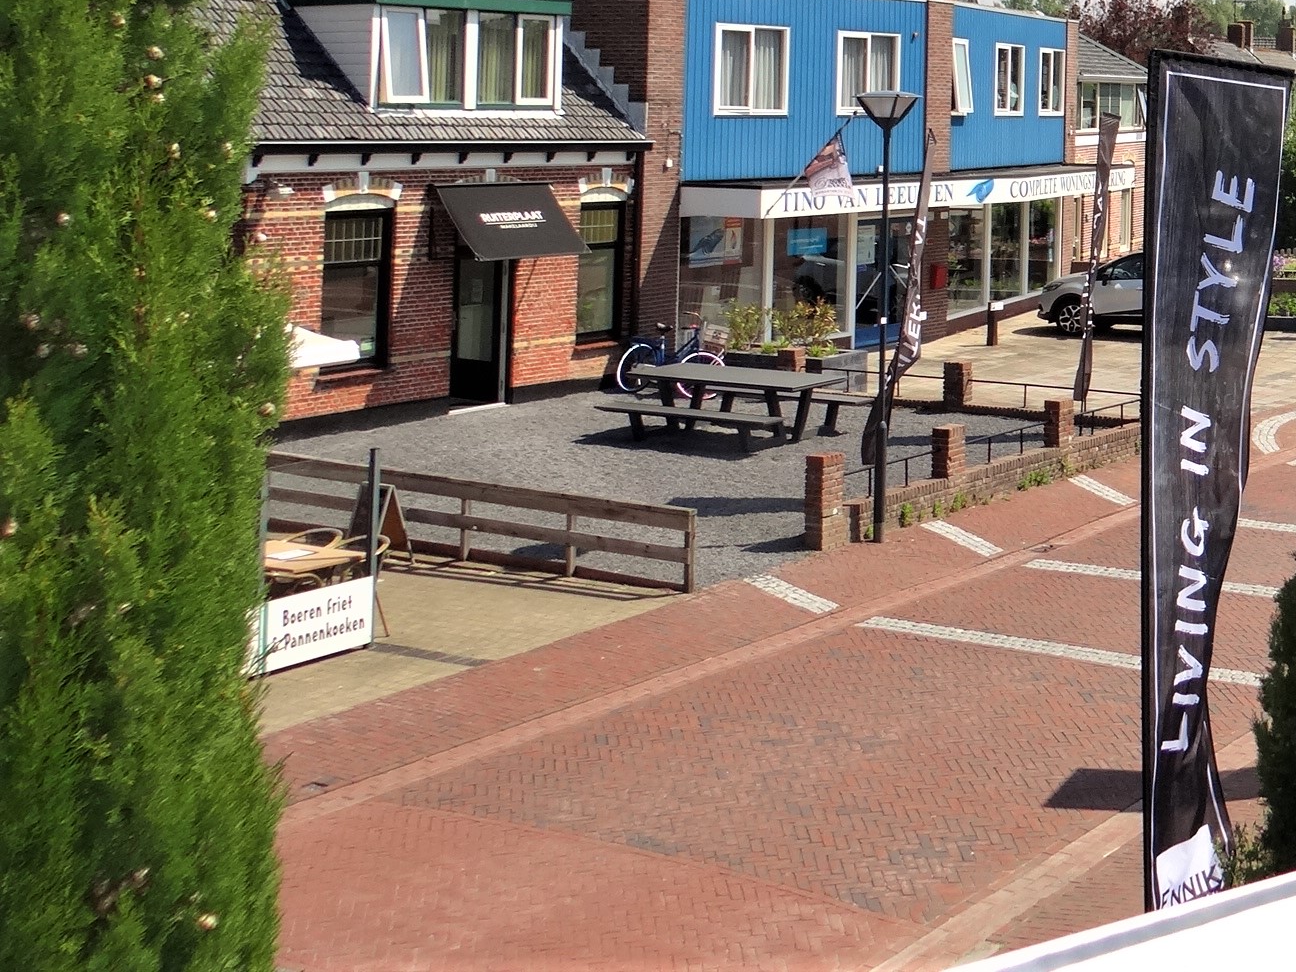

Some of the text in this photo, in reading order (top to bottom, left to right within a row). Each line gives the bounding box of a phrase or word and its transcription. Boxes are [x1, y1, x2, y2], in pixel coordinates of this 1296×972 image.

[782, 191, 826, 212] TINO
[838, 188, 868, 209] VAN
[876, 183, 954, 206] LEEUEN
[1010, 171, 1126, 199] COMPLETE WONINGSTRING
[480, 210, 544, 223] RUITERPLAAT
[1161, 169, 1256, 753] LIVING IN STYLE
[282, 609, 322, 627] Boeren
[284, 617, 365, 650] Pannenkoeken
